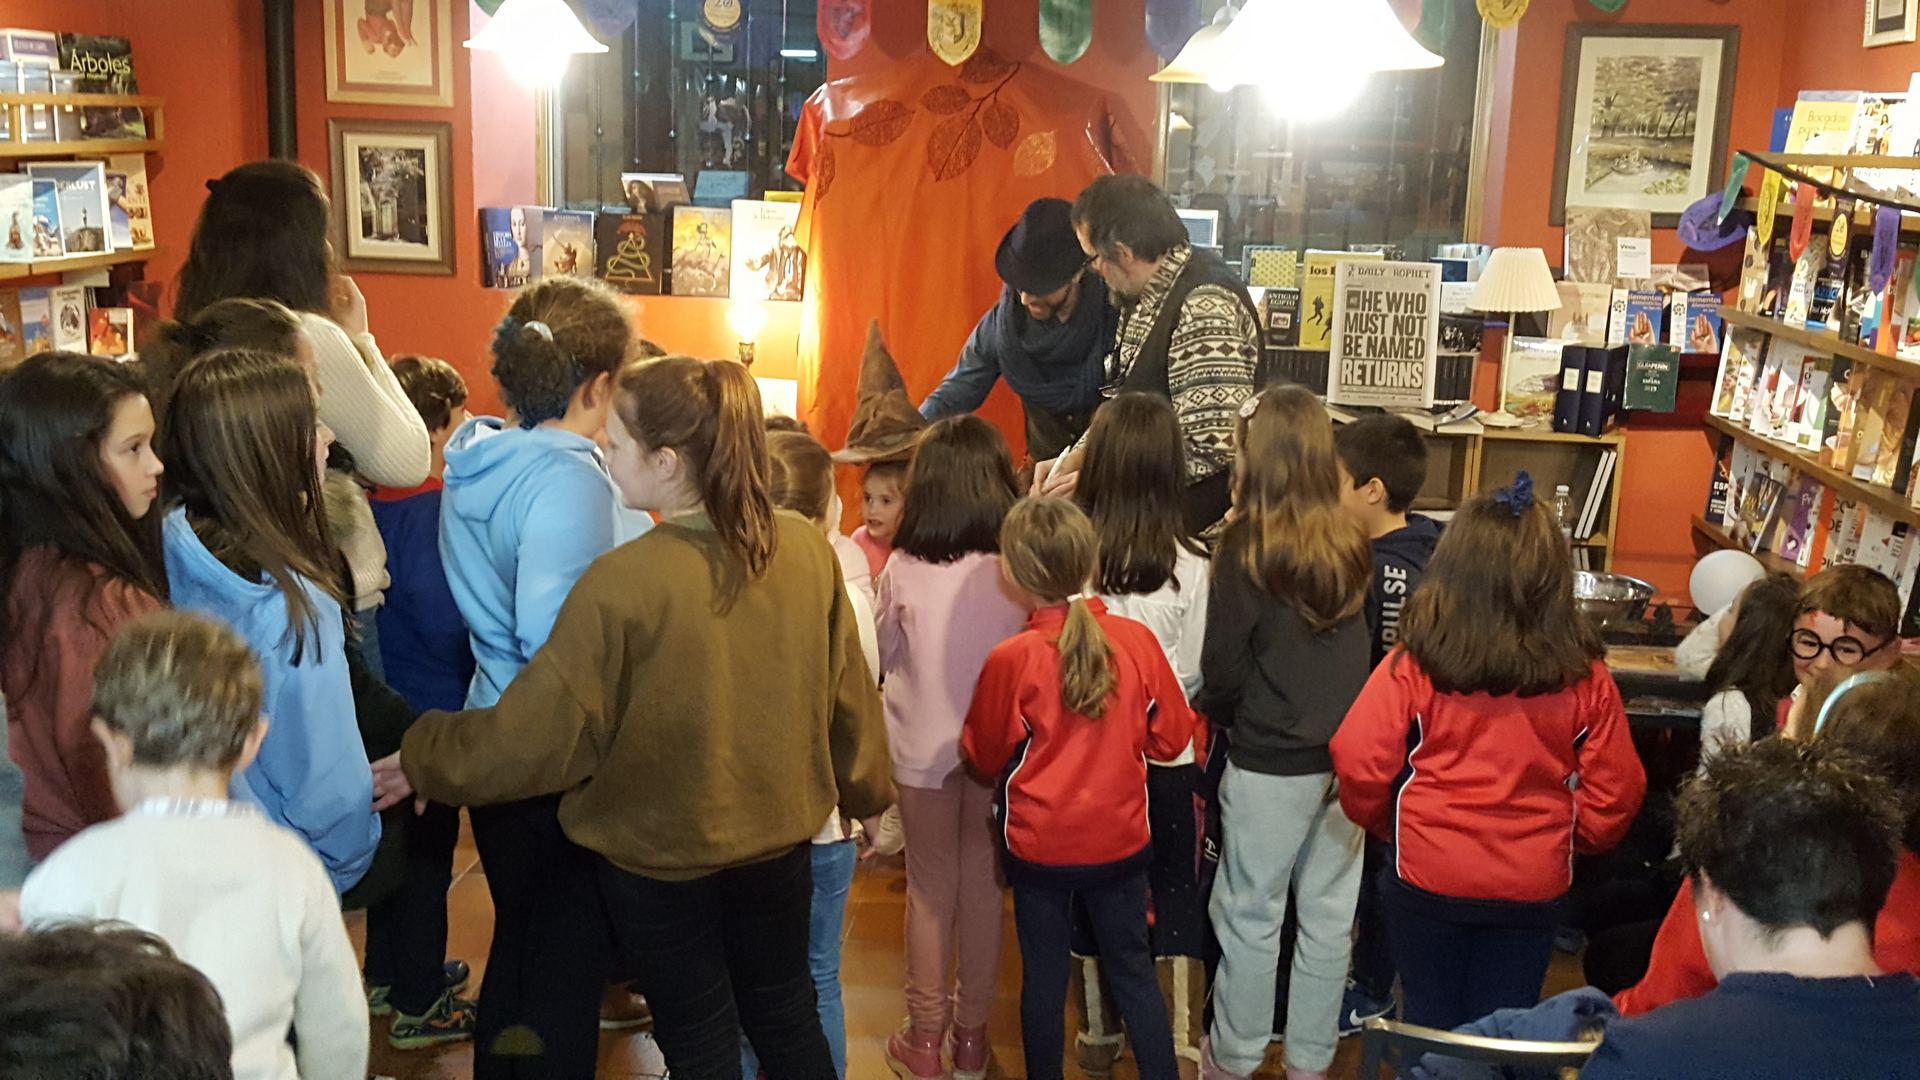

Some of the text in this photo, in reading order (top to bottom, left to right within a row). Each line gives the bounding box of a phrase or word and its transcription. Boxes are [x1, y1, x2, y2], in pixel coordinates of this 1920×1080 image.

[70, 48, 131, 74] Árboles
[1310, 266, 1328, 275] los
[1358, 267, 1387, 276] DAILY
[1268, 292, 1299, 301] ANTIGUO
[1361, 290, 1383, 313] HE
[1386, 291, 1427, 314] WHO
[1344, 311, 1428, 337] MUST NOT
[1342, 335, 1426, 360] BE NAMED
[1341, 359, 1424, 388] RETURNS
